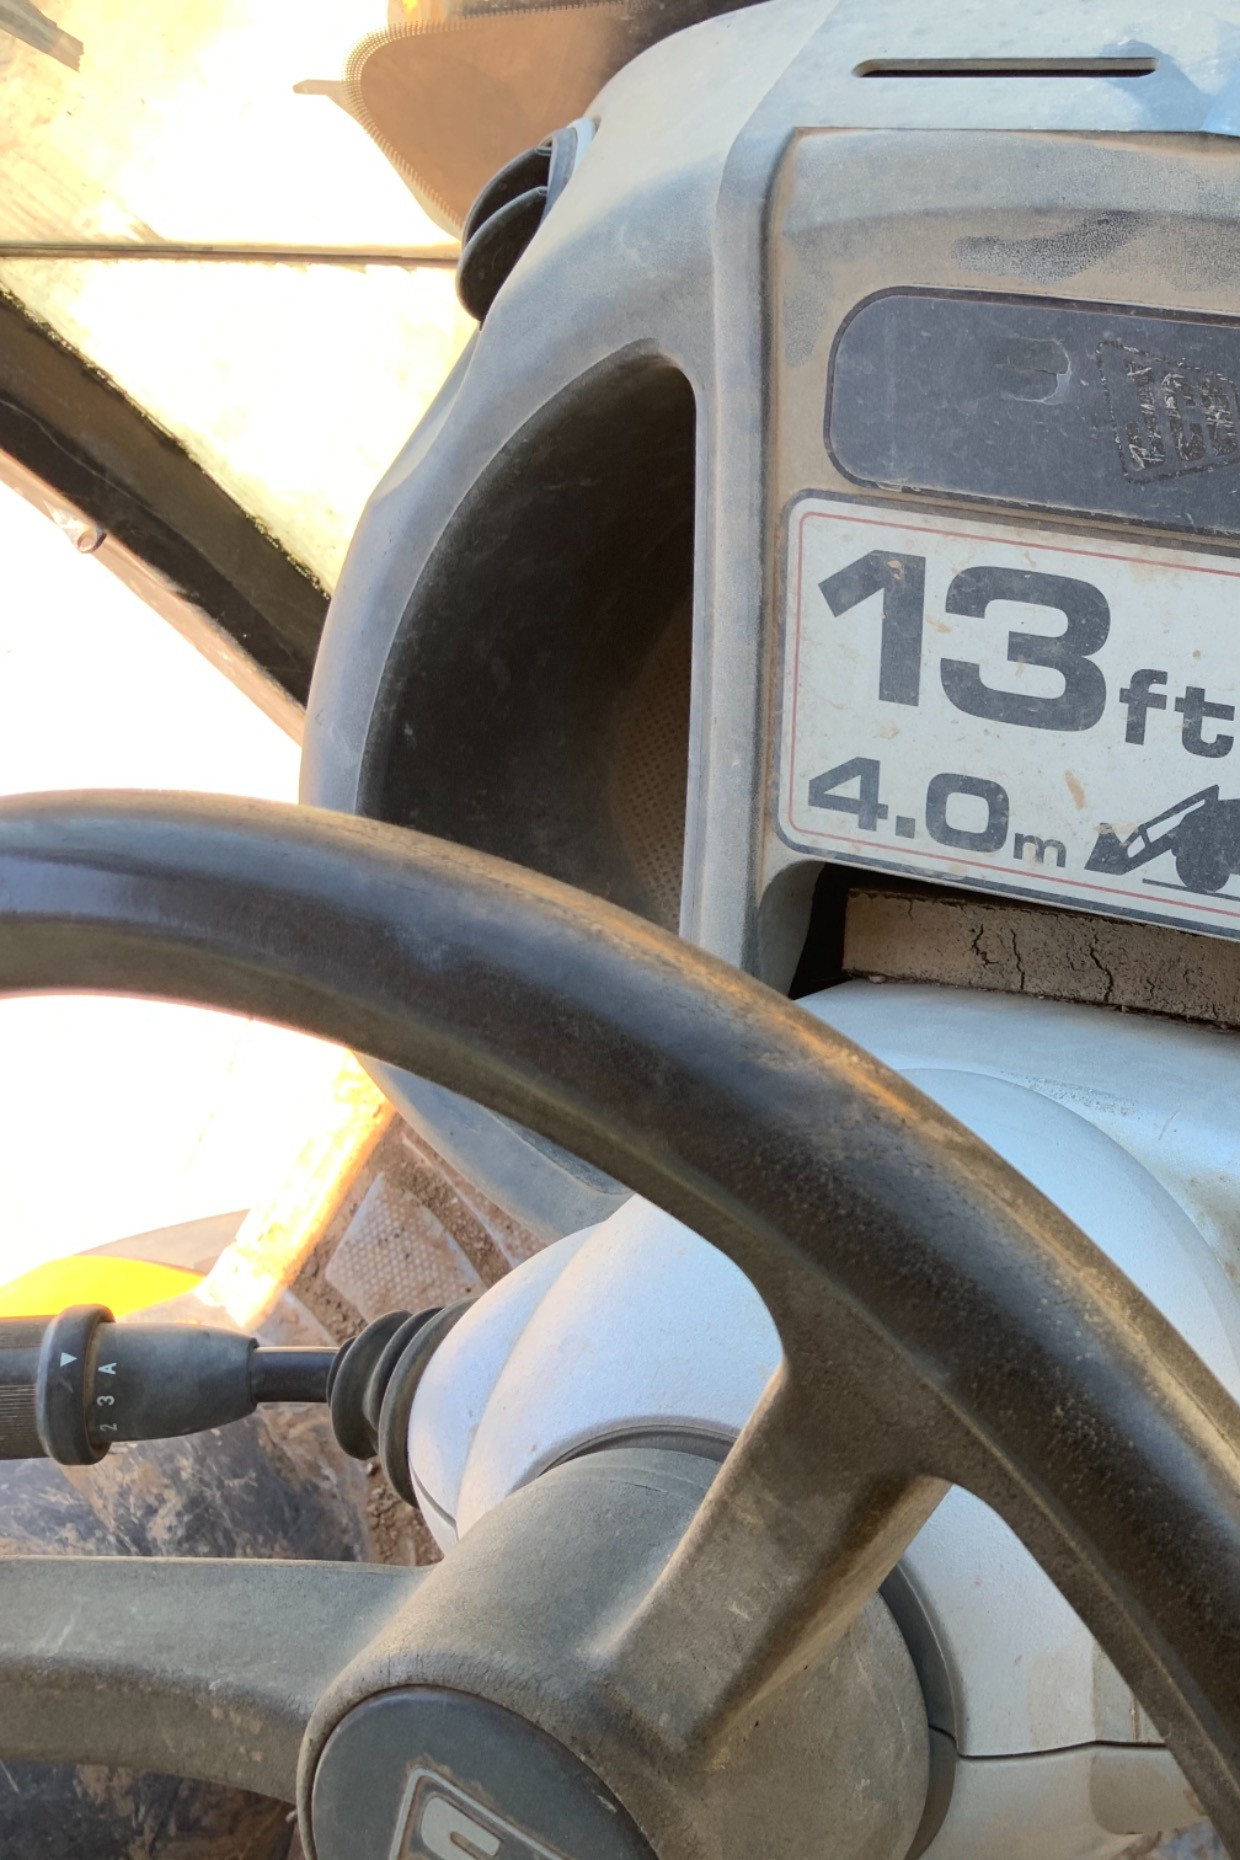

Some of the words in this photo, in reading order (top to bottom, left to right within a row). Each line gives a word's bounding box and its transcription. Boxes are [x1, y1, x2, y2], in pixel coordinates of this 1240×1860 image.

[97, 1362, 118, 1375] A
[96, 1395, 115, 1407] 3
[99, 1422, 118, 1432] 2
